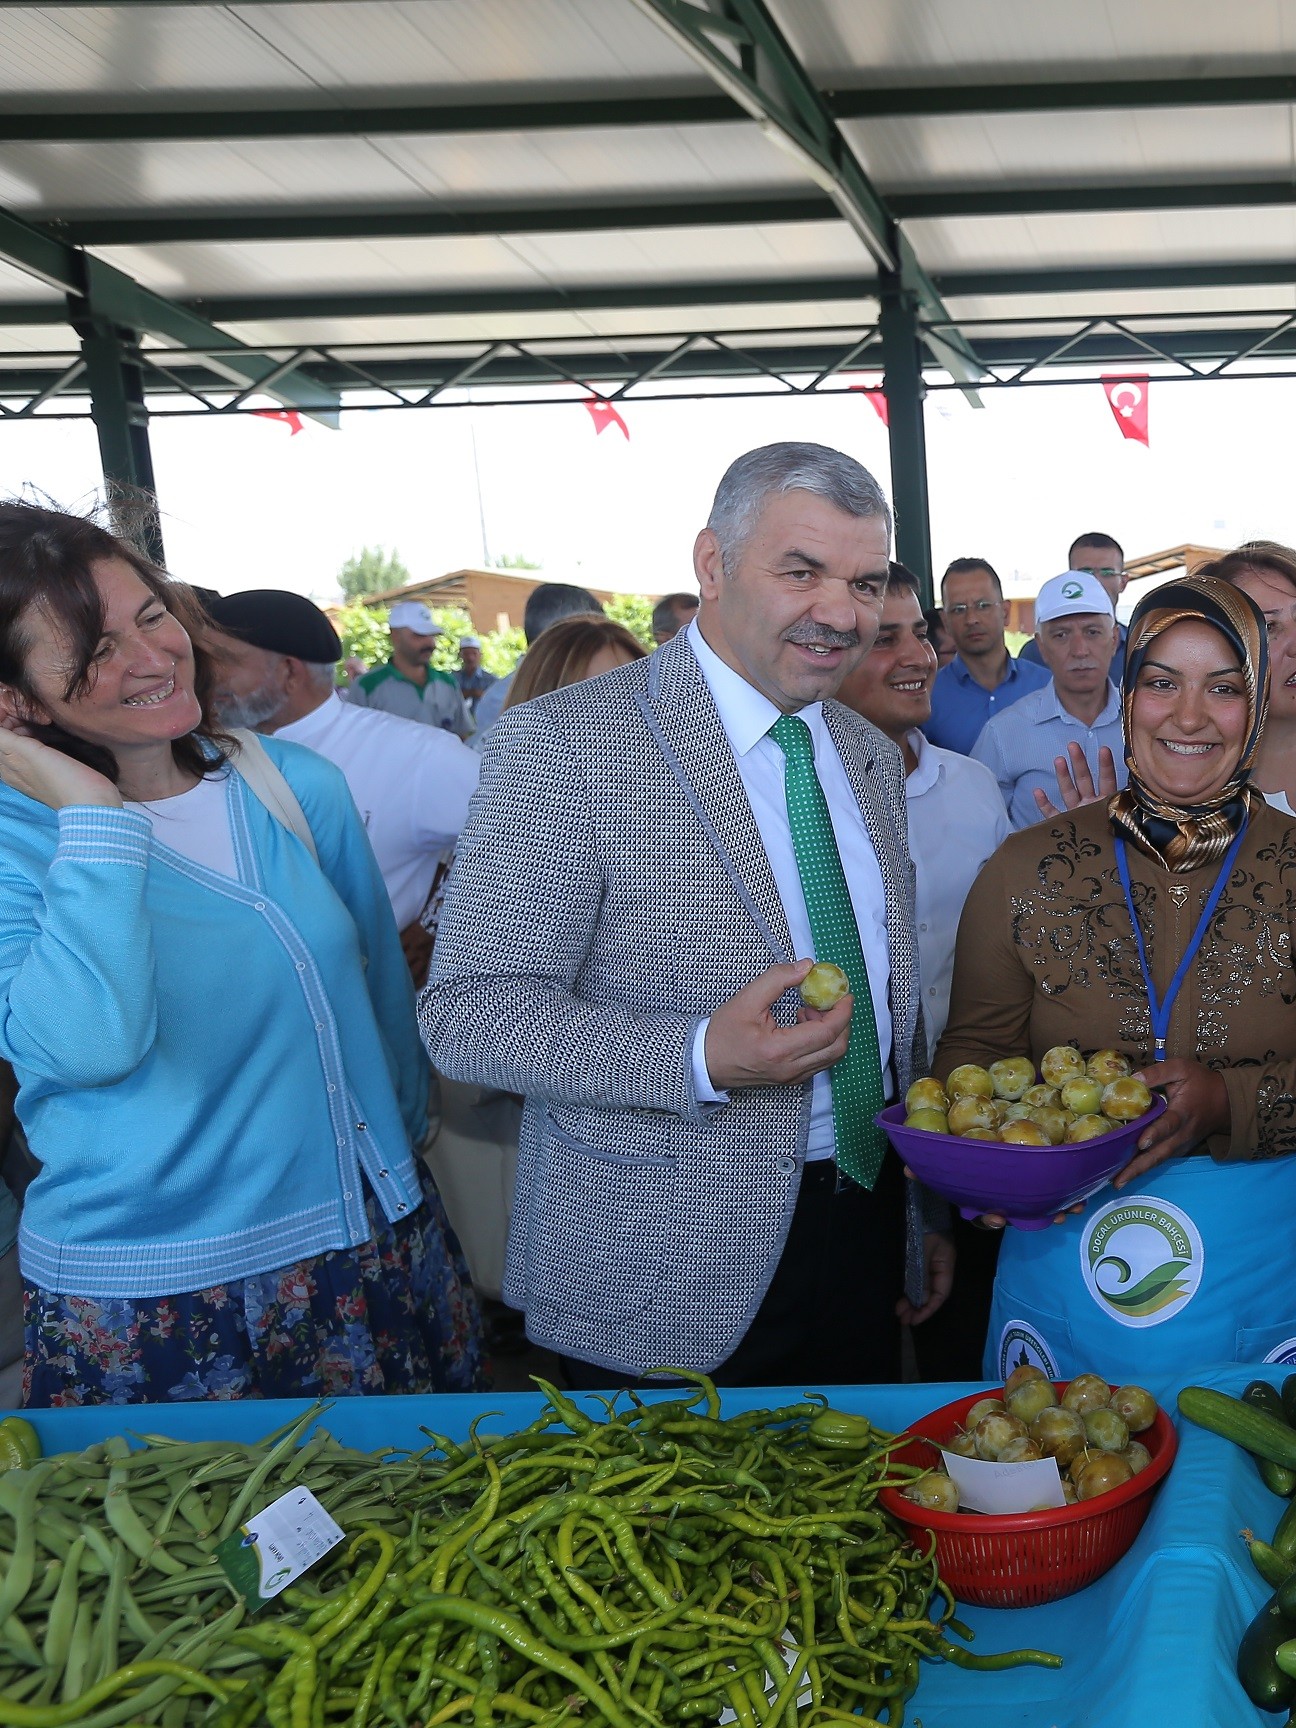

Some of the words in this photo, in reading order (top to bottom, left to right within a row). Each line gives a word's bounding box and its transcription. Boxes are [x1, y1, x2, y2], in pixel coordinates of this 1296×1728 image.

[1092, 1224, 1112, 1253] DOĞAL
[1111, 1210, 1158, 1225] ÜRÜNLER
[1158, 1216, 1189, 1255] BAHÇESİ
